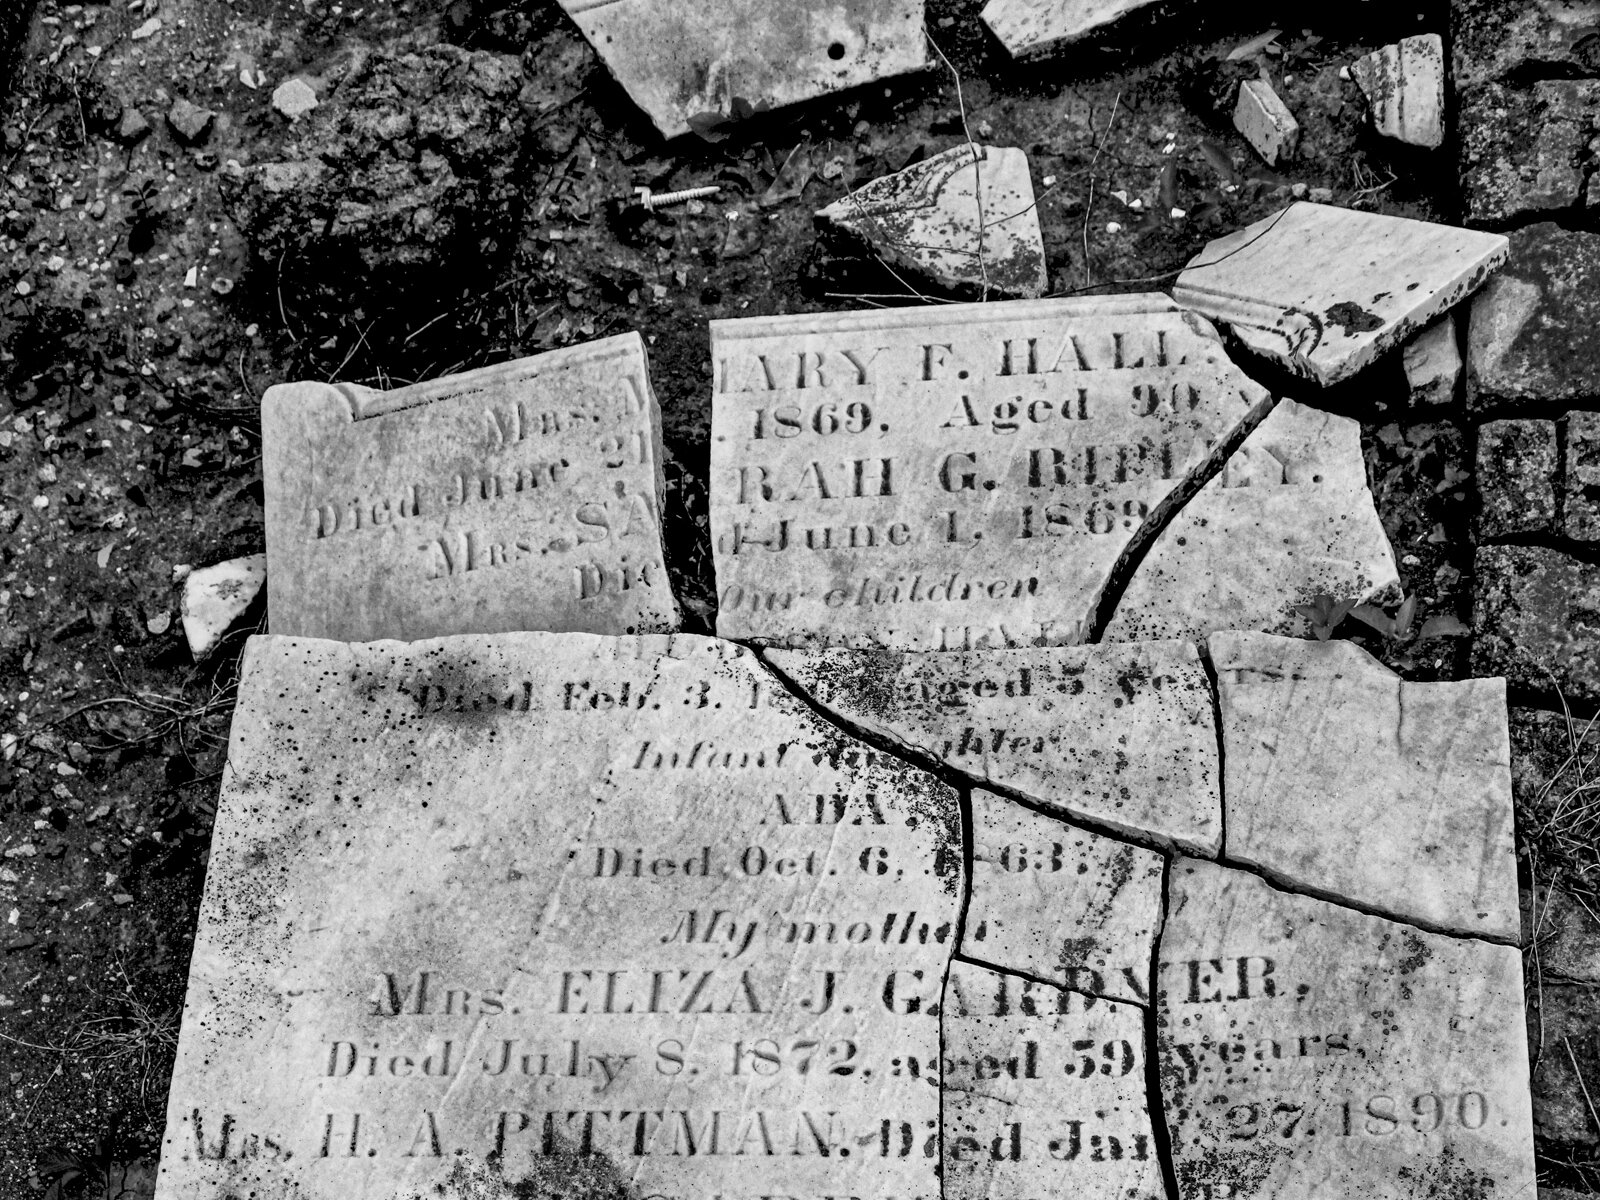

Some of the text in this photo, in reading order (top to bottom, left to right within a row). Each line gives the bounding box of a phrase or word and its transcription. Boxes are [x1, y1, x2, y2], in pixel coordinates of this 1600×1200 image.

[938, 380, 1095, 436] Aged
[311, 484, 421, 539] Died
[824, 573, 1042, 611] children
[592, 845, 714, 878] Died
[739, 845, 837, 878] Oct.
[367, 970, 523, 1019] Mrs.
[551, 969, 773, 1015] ELIZA
[801, 968, 856, 1017] J.
[318, 1038, 455, 1078] Died
[481, 1037, 638, 1092] July
[1064, 1040, 1137, 1079] 59
